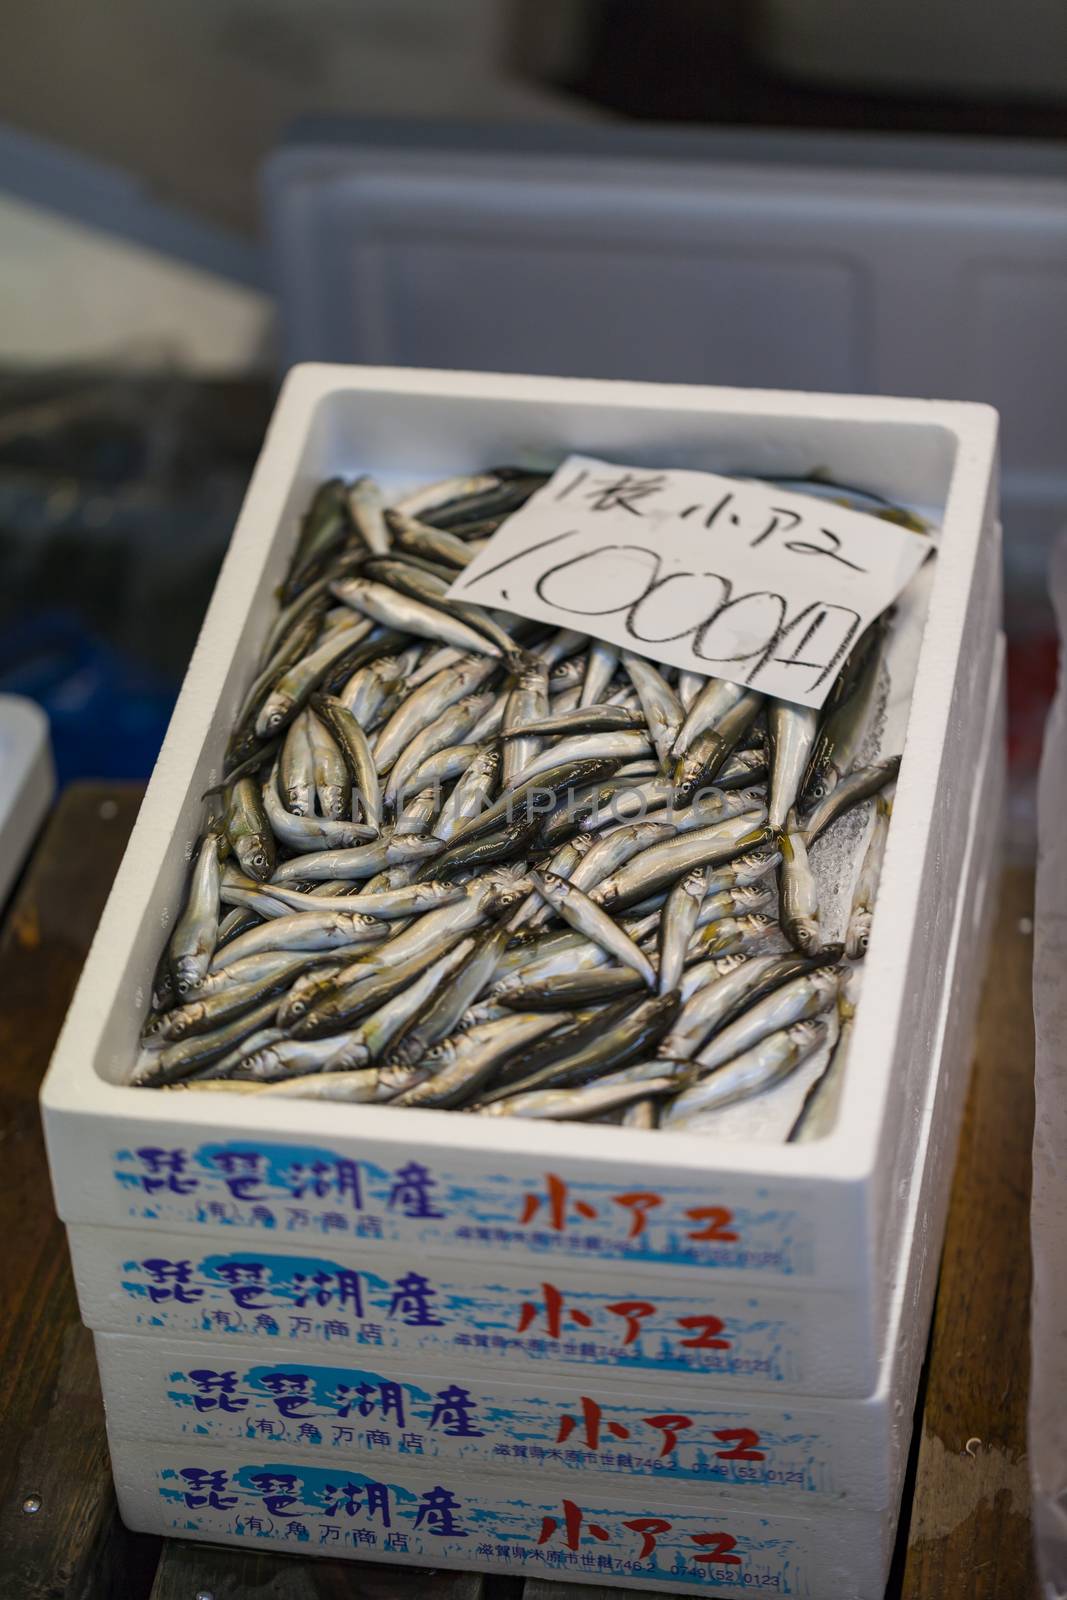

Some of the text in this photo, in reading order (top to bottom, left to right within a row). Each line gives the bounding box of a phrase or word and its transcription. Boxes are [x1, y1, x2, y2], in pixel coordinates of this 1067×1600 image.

[136, 1146, 739, 1242] 琵琶湖産 小アユ
[141, 1258, 732, 1349] 琵琶湖産 小アユ
[188, 1369, 765, 1461] 琵琶湖産 小アユ
[179, 1468, 742, 1565] 琵琶湖産 小アユ
